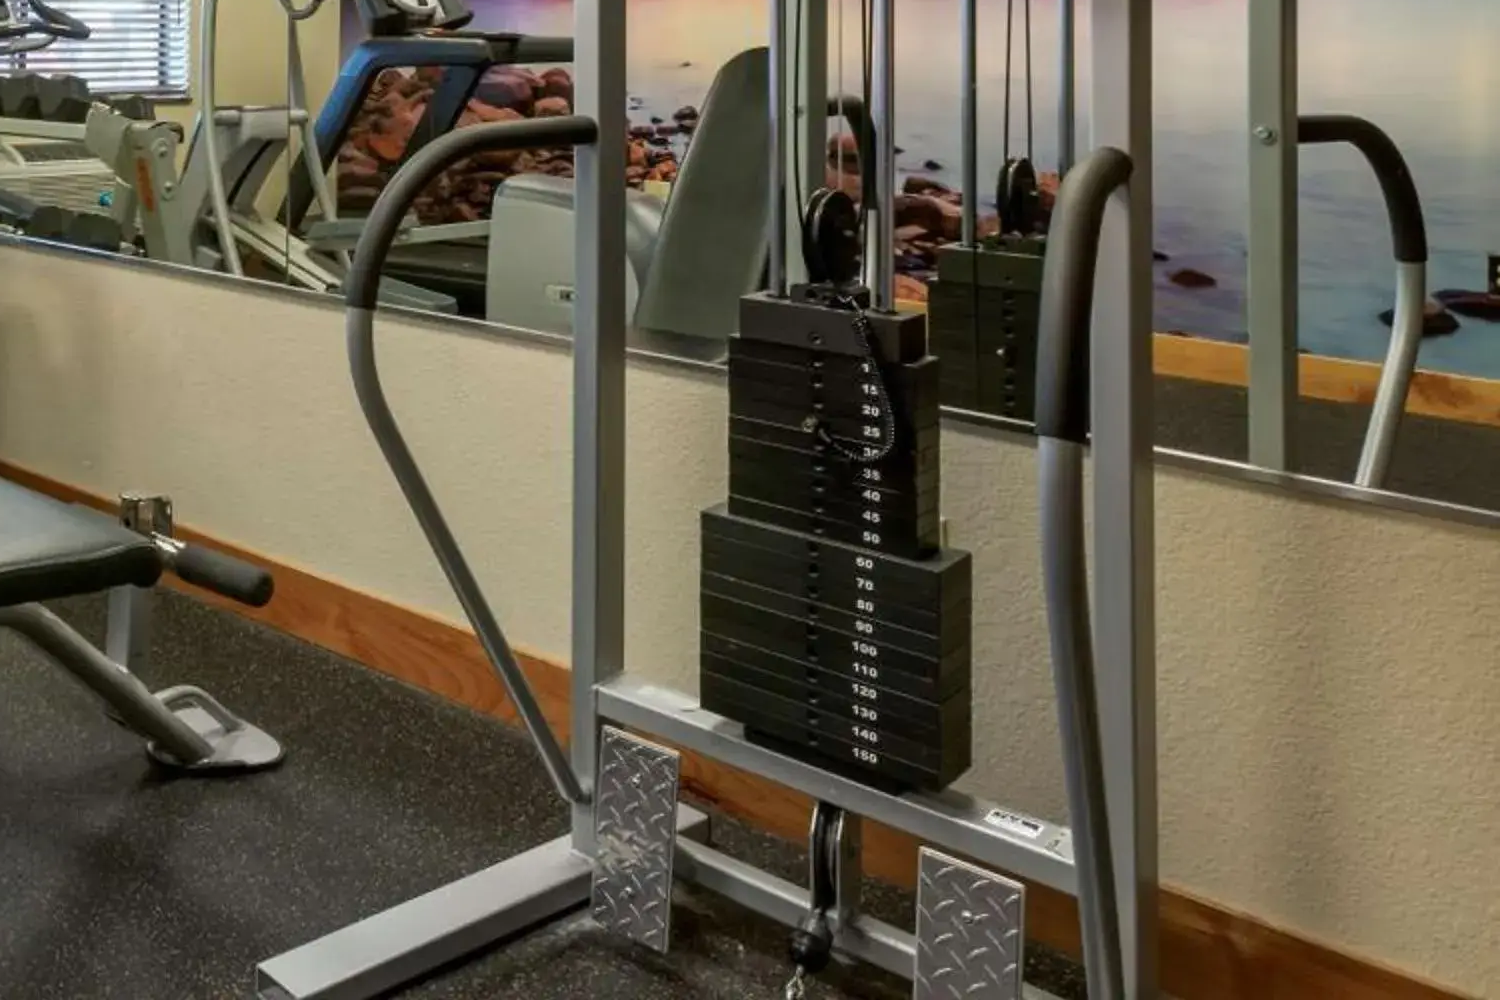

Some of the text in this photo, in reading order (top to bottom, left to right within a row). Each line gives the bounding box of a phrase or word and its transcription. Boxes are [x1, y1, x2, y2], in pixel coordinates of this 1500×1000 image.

[861, 383, 878, 395] 15
[861, 404, 880, 417] 20
[863, 425, 880, 438] 25
[862, 467, 881, 481] 35
[862, 489, 881, 502] 40
[862, 510, 881, 523] 45
[862, 531, 881, 544] 50
[855, 557, 873, 569] 60
[855, 577, 874, 591] 70
[856, 599, 874, 612] 80
[855, 620, 873, 634] 90
[852, 641, 878, 657] 100
[852, 662, 878, 678] 110
[851, 683, 877, 699] 120
[852, 704, 877, 721] 130
[852, 726, 878, 742] 140
[852, 747, 878, 764] 150
